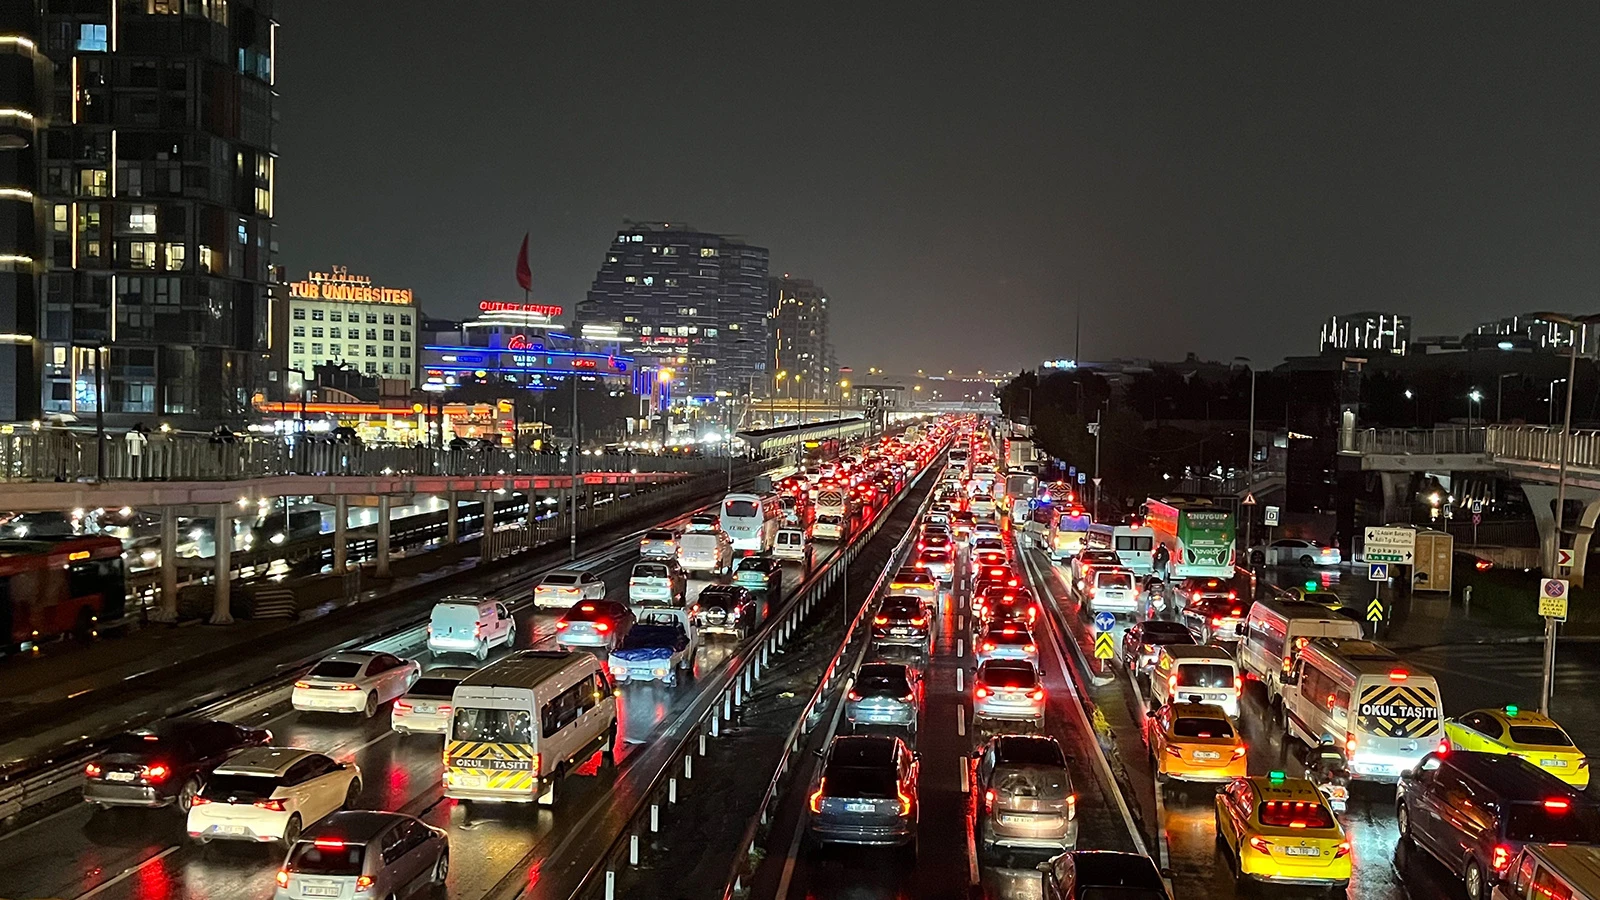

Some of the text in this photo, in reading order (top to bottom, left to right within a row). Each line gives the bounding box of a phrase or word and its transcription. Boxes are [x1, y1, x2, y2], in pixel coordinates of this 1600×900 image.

[322, 282, 413, 305] ÜNİVERSİTESİ
[480, 301, 562, 315] OUTLET CENTER
[1368, 546, 1401, 554] Topkapı
[1367, 554, 1403, 562] Ankara
[1362, 704, 1437, 719] OKUL TAŞITI
[456, 759, 484, 768] OKUL
